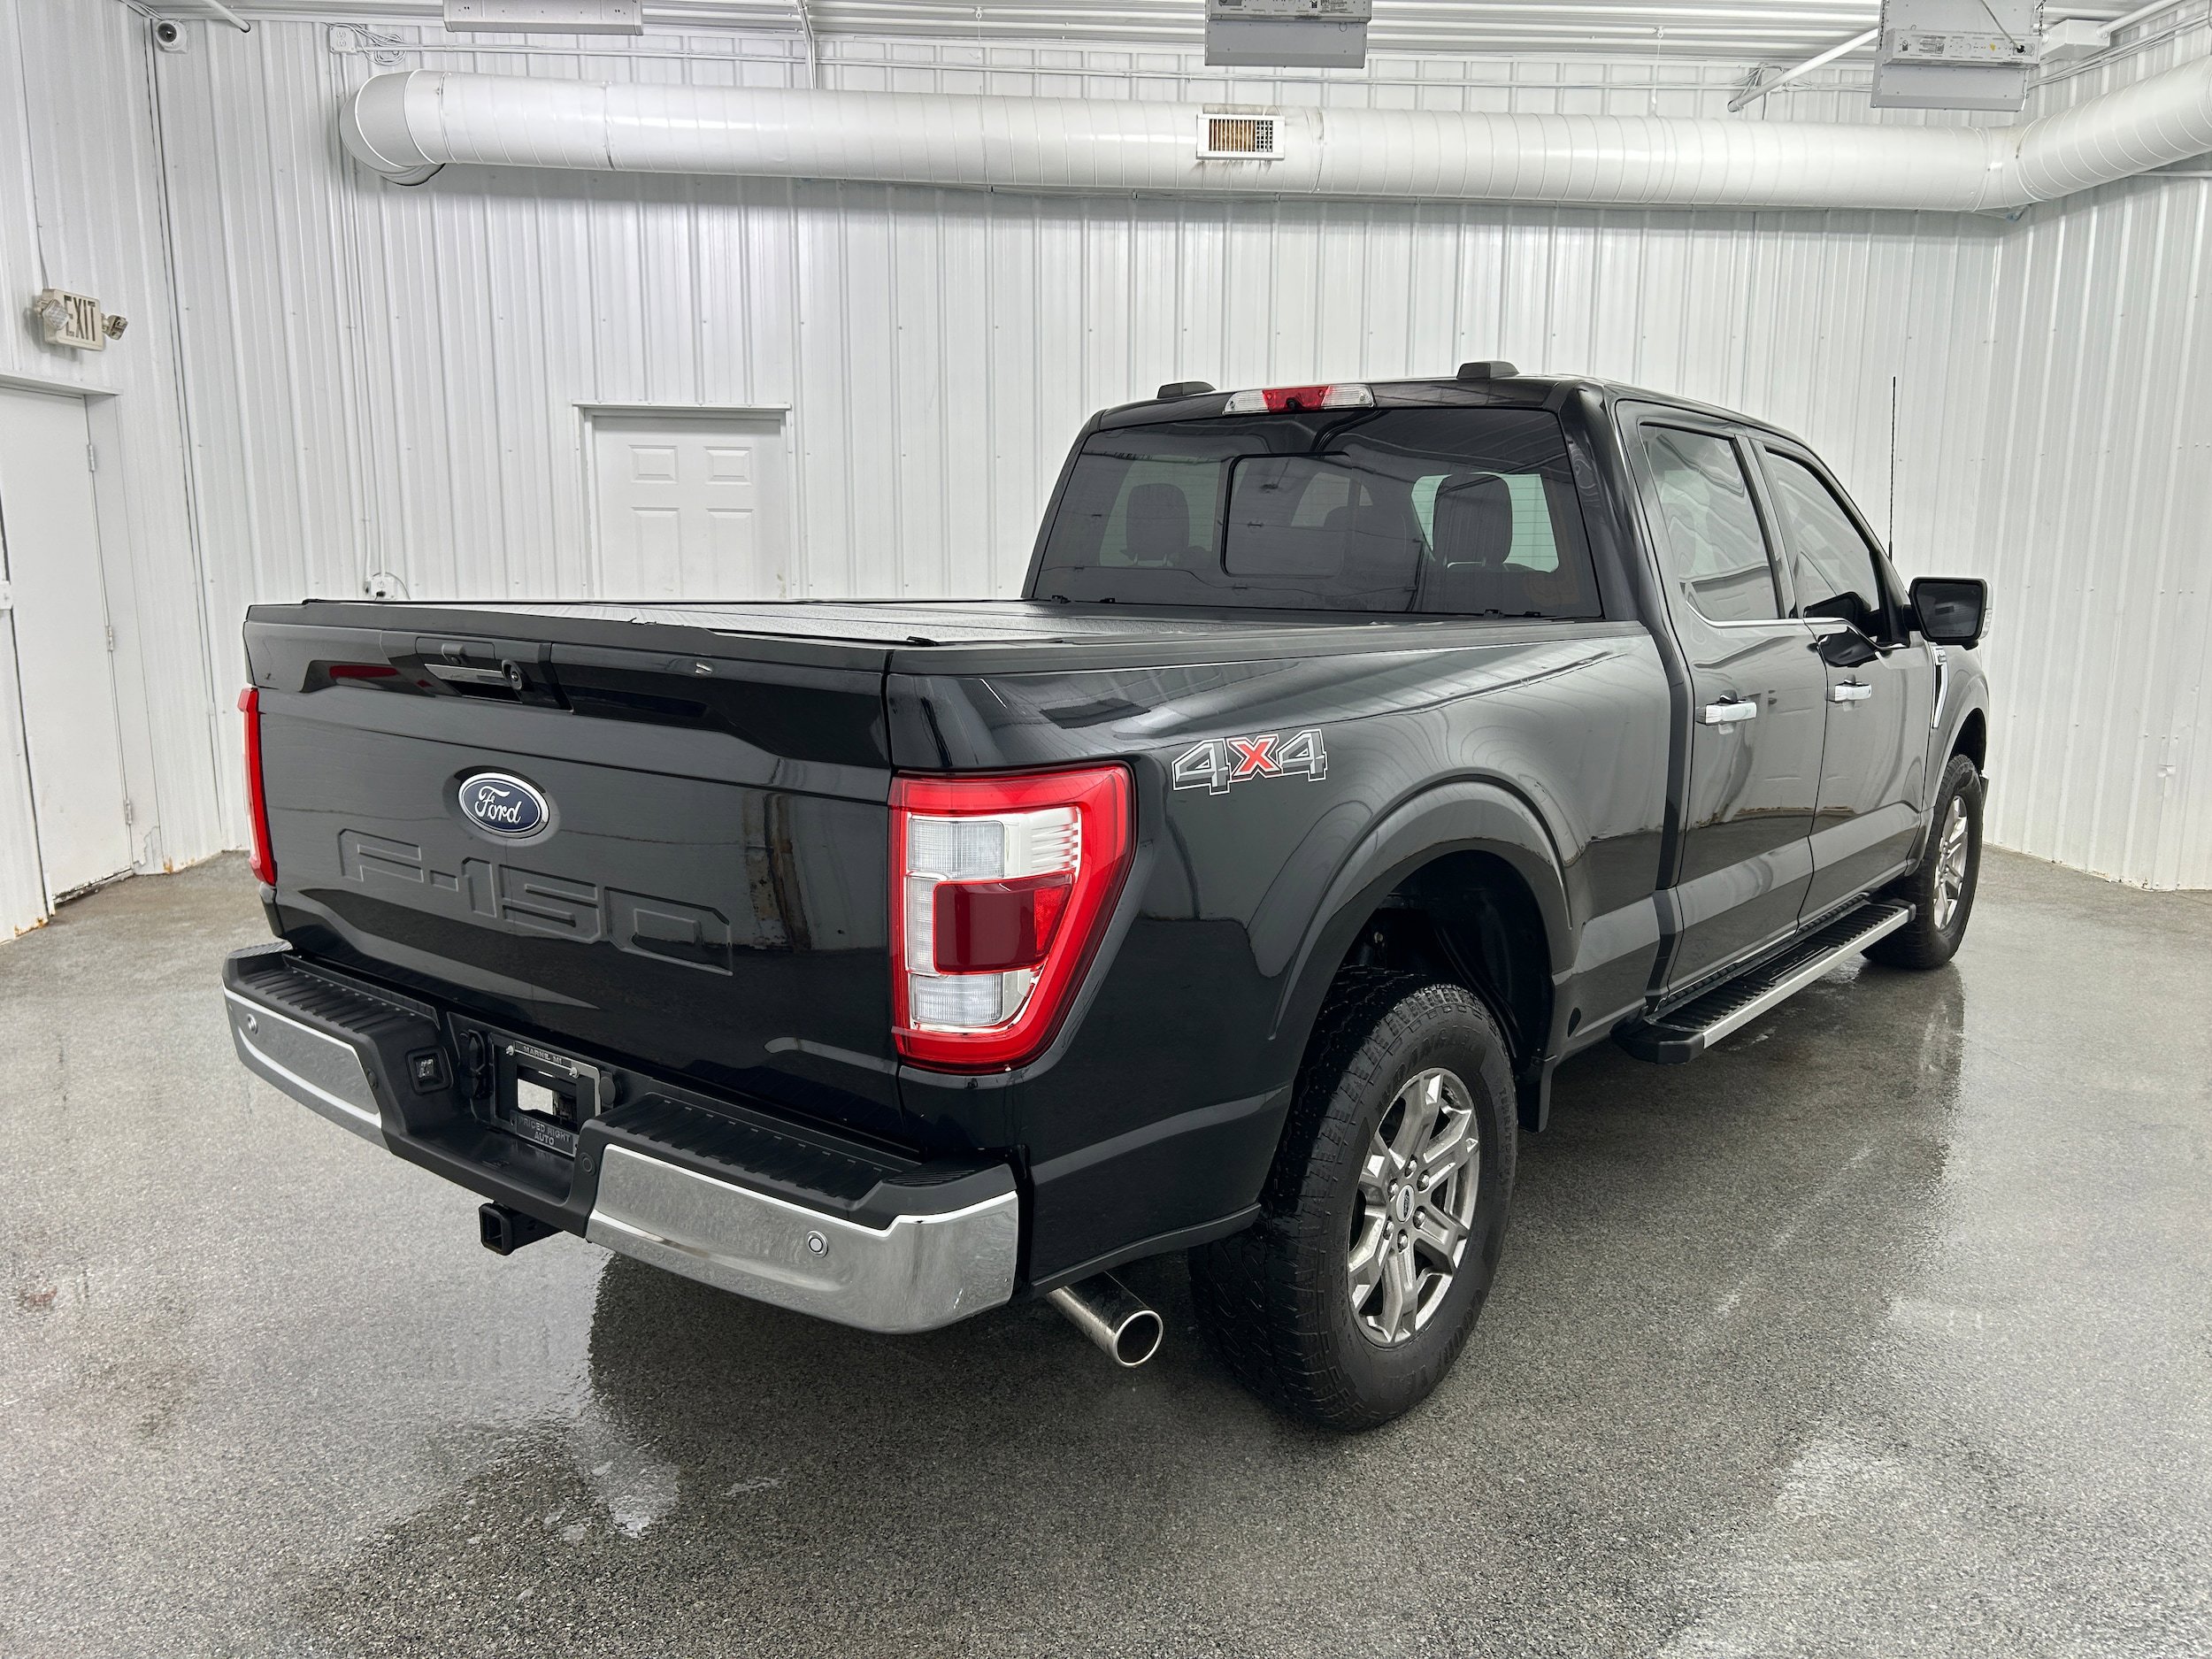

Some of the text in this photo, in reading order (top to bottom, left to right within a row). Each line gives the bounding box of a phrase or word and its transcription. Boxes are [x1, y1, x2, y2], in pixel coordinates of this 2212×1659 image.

[64, 295, 96, 342] EXIT
[474, 785, 522, 826] Ford
[337, 828, 733, 977] F-150
[518, 1116, 572, 1143] PRICED RIGHT
[534, 1132, 555, 1145] AUTO
